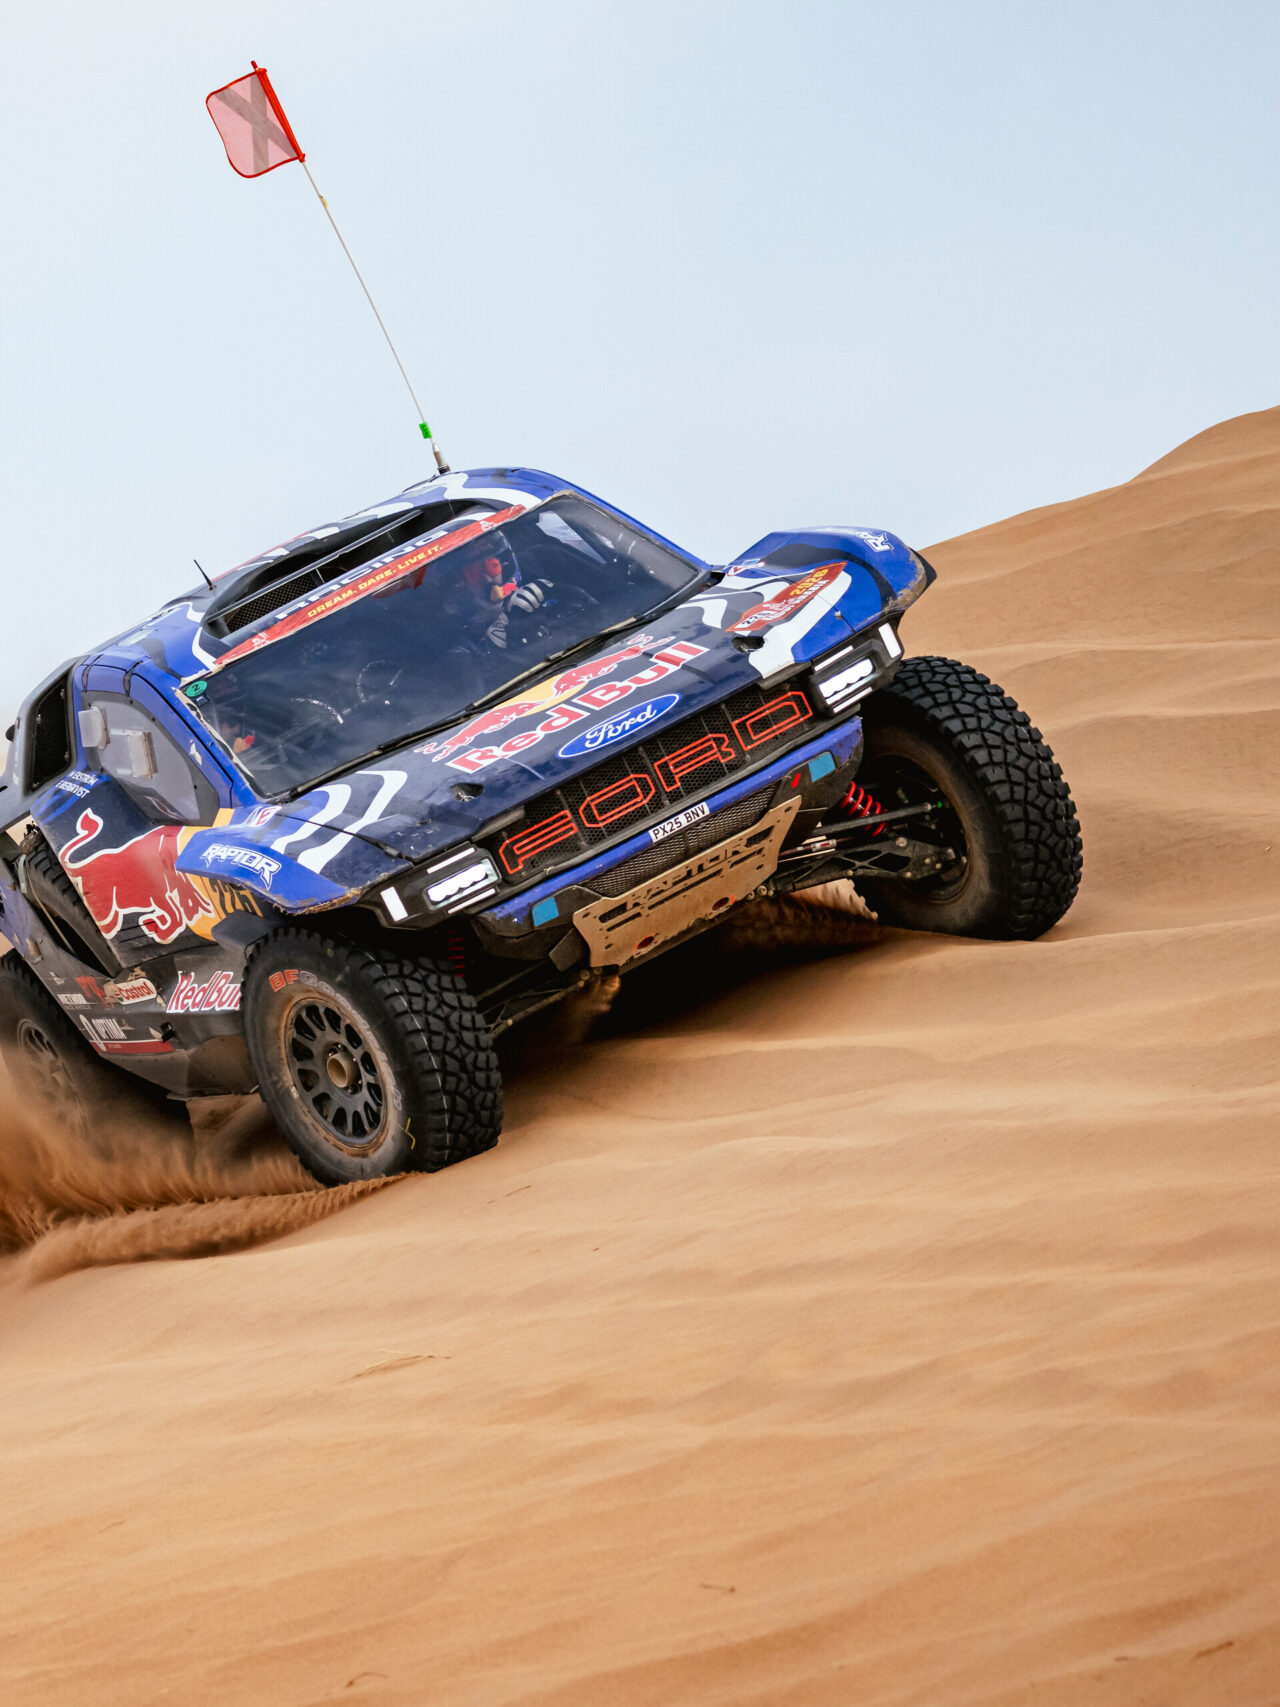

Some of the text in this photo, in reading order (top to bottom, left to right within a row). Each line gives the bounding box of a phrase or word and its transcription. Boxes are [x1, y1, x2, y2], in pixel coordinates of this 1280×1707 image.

[275, 530, 448, 620] RACING
[307, 543, 445, 618] DREAM. DARE. LIVE IT.
[790, 568, 828, 596] 2026
[584, 704, 657, 748] Ford
[499, 691, 813, 874] FORD
[652, 805, 708, 840] PX25 BNV
[200, 843, 282, 890] RAPTOR
[119, 980, 154, 1001] Castrol
